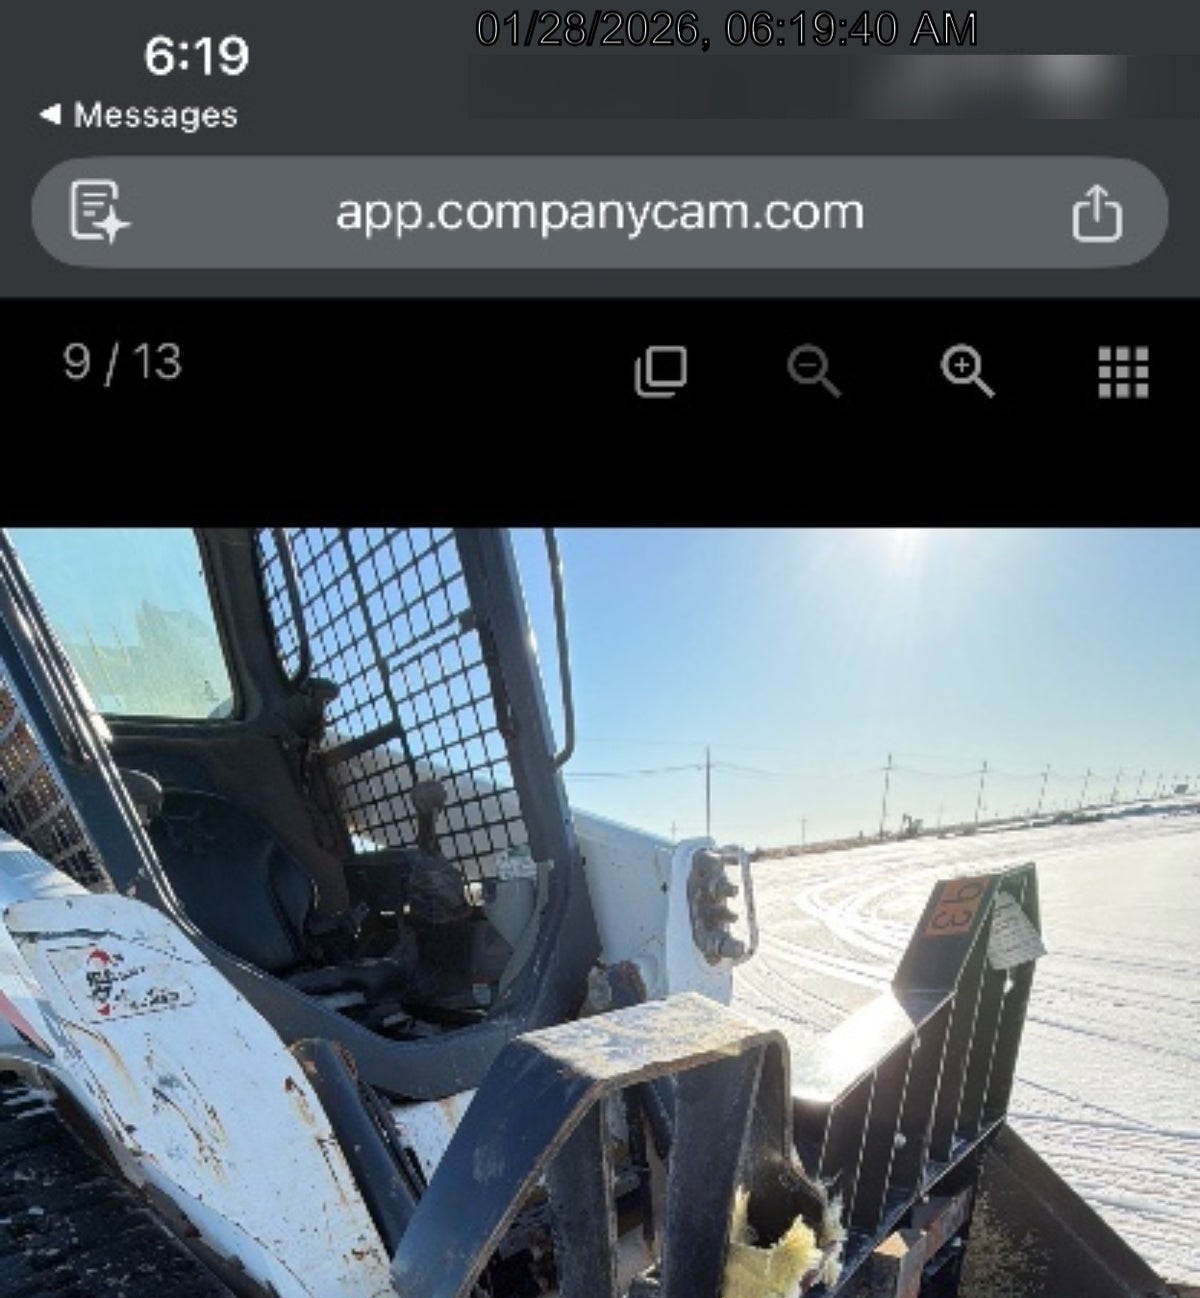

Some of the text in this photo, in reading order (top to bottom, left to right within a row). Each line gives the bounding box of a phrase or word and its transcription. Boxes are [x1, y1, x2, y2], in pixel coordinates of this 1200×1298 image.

[144, 34, 250, 77] 6:19
[73, 100, 239, 134] Messages
[336, 194, 865, 239] app.companycam.com
[63, 342, 91, 380] 9
[134, 342, 182, 380] 13
